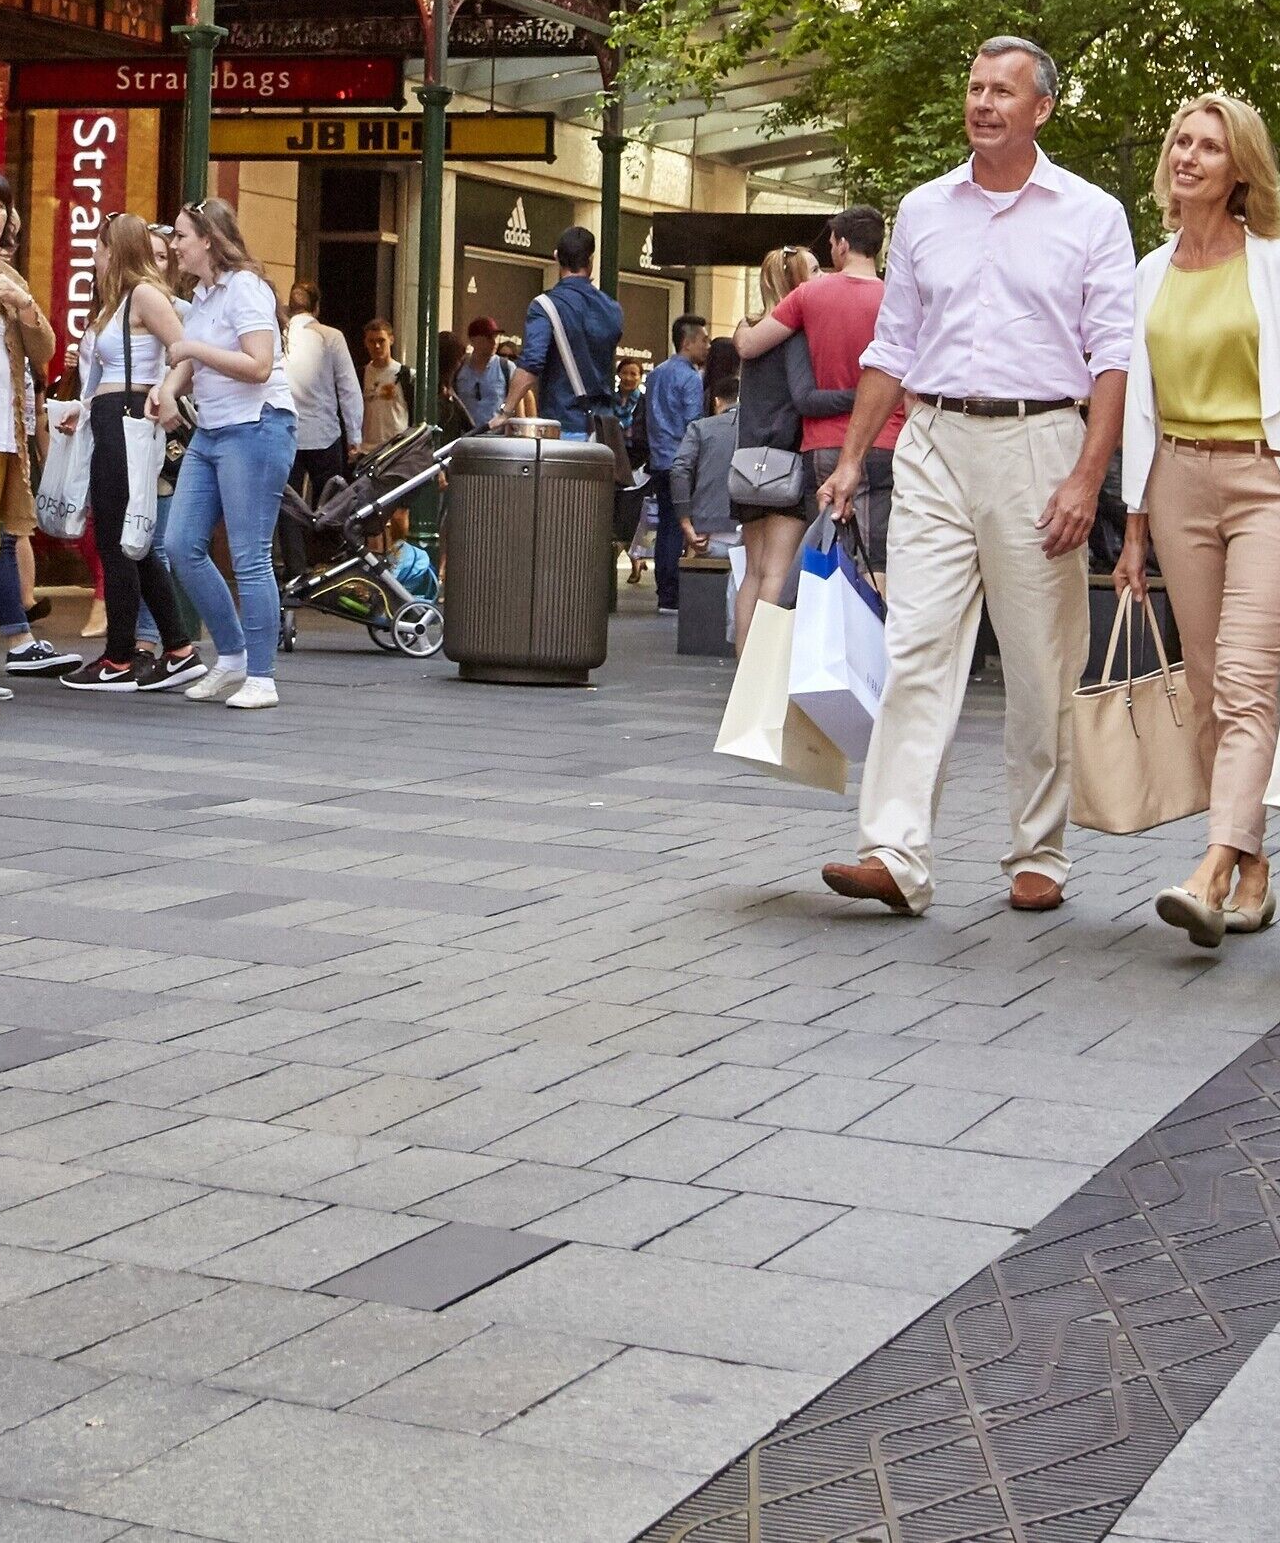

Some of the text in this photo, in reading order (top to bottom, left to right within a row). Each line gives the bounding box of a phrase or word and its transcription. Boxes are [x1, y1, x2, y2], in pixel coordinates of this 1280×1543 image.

[116, 64, 291, 97] Stradbags
[287, 121, 452, 151] JB HI-
[66, 116, 116, 350] Strandb
